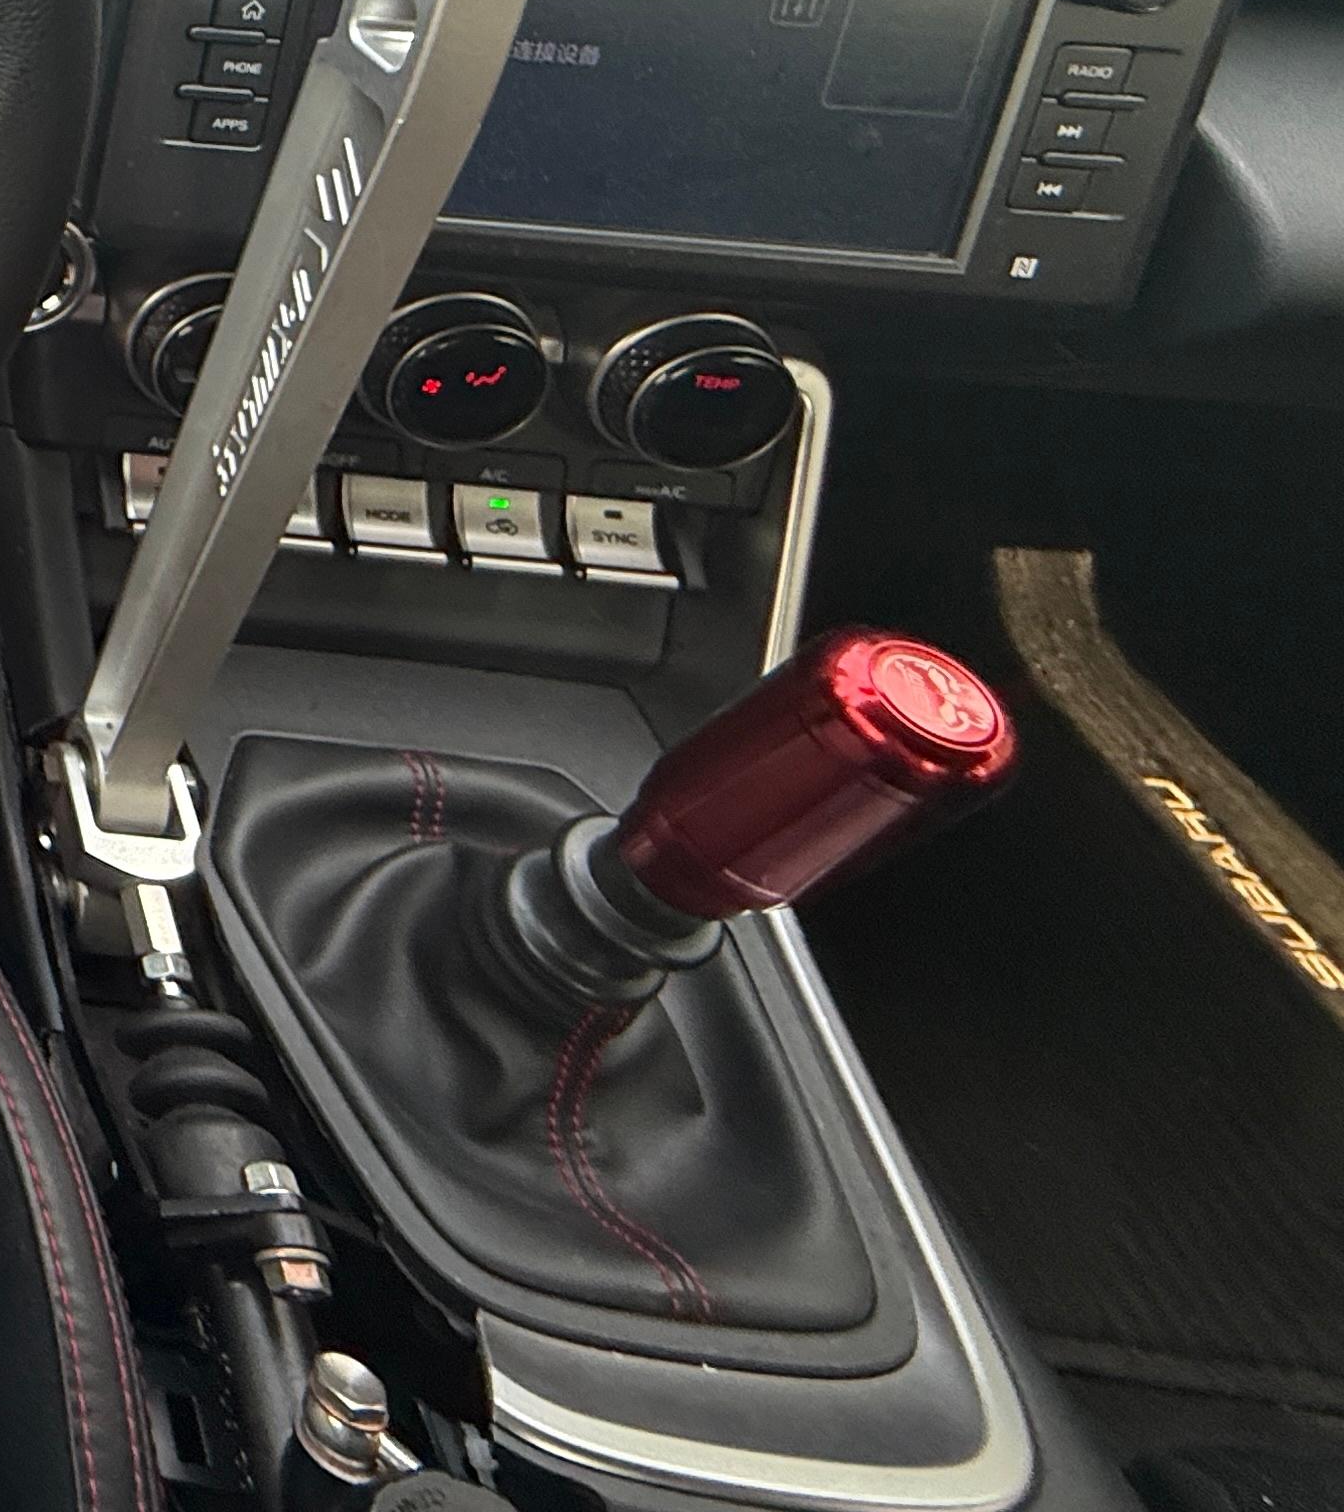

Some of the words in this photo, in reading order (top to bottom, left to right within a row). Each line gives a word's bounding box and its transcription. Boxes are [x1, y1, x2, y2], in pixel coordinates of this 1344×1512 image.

[223, 60, 263, 75] PHONE
[1067, 63, 1113, 79] RADIO
[213, 118, 249, 132] APPS
[695, 374, 741, 390] TEMP
[479, 466, 509, 483] A/C
[365, 509, 411, 523] MODE
[592, 529, 639, 546] SYNC
